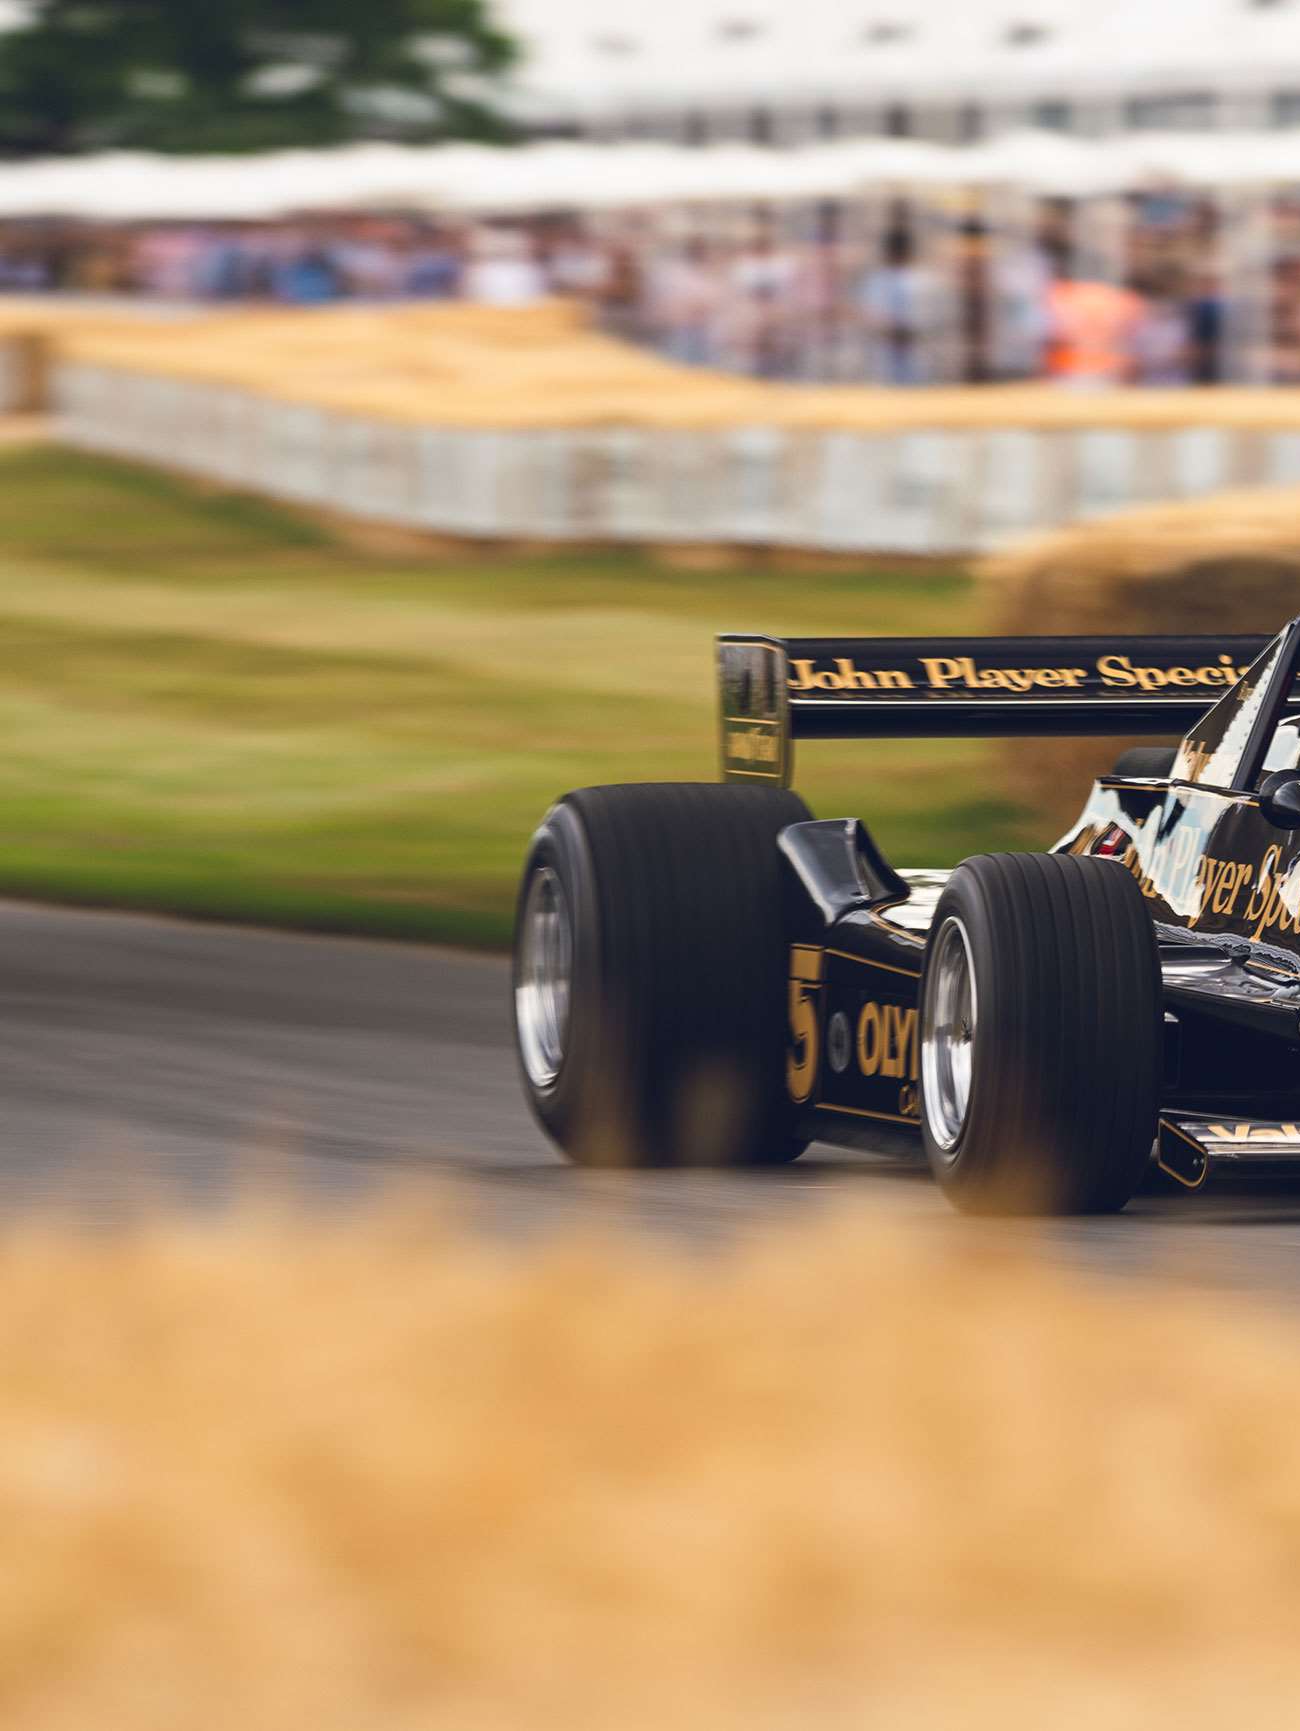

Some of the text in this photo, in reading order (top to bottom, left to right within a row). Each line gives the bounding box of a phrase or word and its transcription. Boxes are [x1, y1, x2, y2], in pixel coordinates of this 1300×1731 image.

[786, 657, 917, 691] John
[919, 656, 1088, 692] Player
[787, 949, 822, 1103] 5
